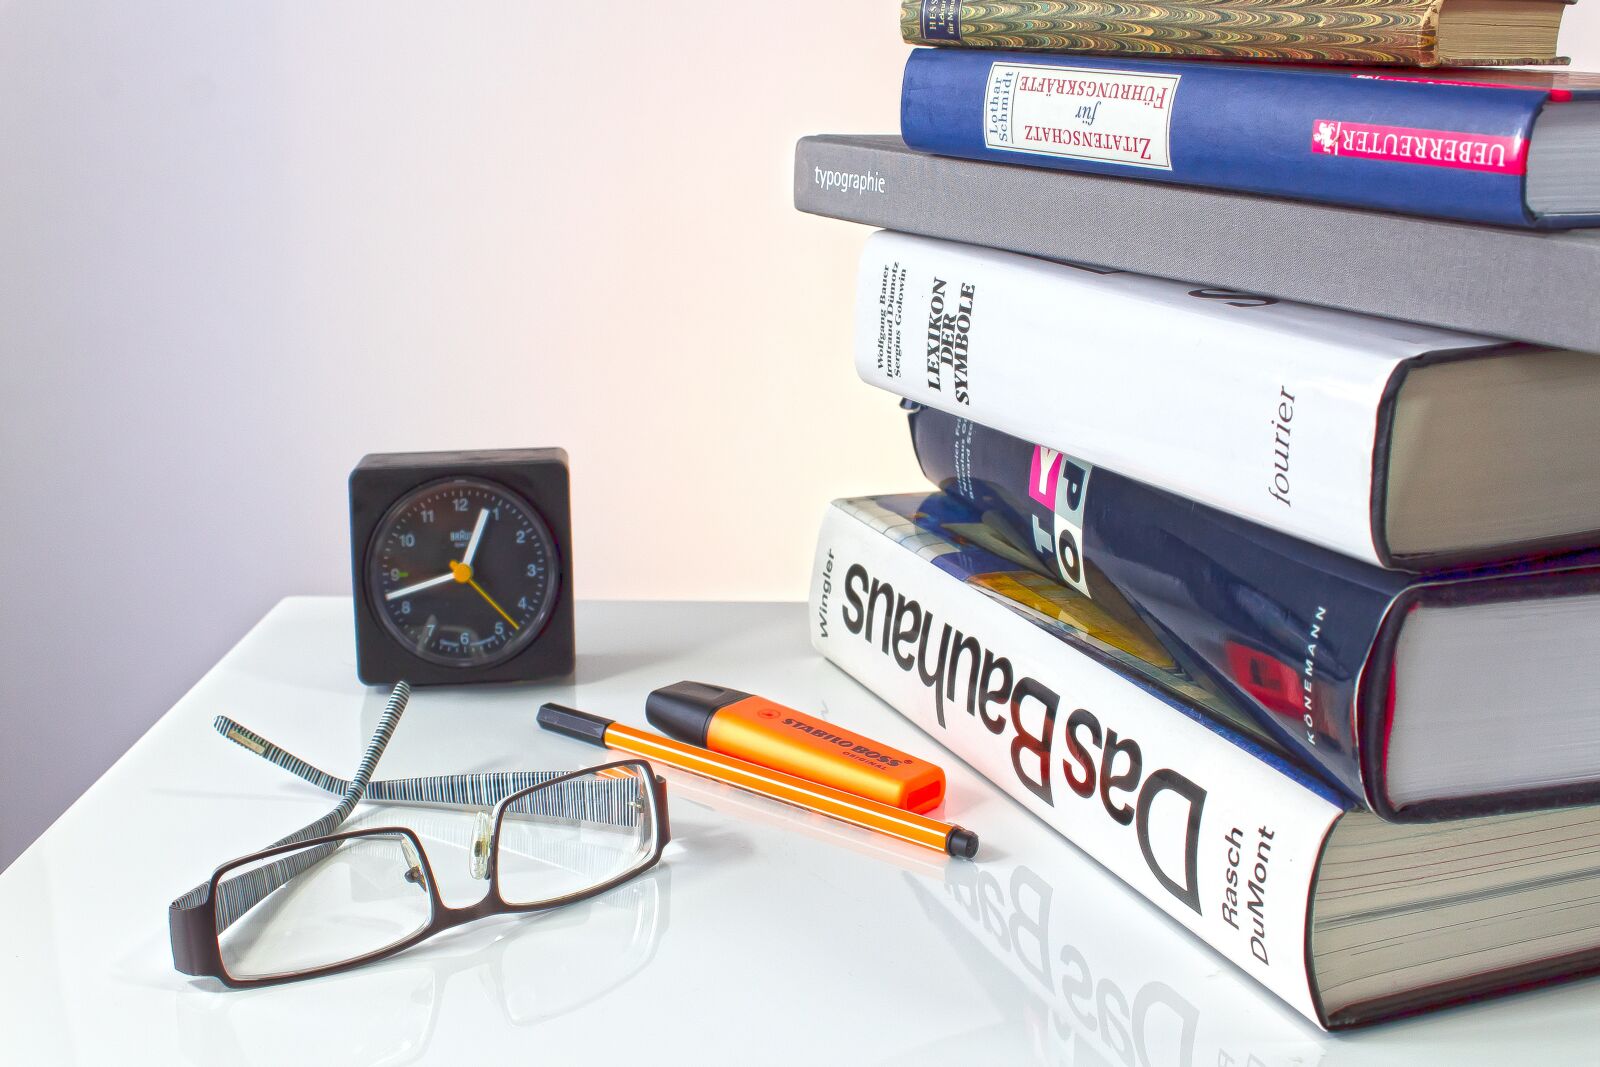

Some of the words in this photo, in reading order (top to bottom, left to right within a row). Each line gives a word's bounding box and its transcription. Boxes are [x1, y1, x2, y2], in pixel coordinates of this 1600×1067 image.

[989, 77, 1003, 134] Lothar
[999, 72, 1014, 142] Schmidt
[1019, 76, 1168, 109] FÜHRUNGSKRÄFTE
[1075, 101, 1102, 126] für
[1024, 125, 1152, 160] ZITATENSCHATZ
[1342, 130, 1506, 167] UEBERREUTER
[814, 166, 886, 195] typographie
[879, 265, 890, 305] Bauer
[886, 261, 900, 316] Dümotz
[894, 268, 907, 326] Golowin
[877, 308, 888, 369] Wolfgang
[886, 320, 894, 378] Irmtraud
[927, 276, 947, 392] LEXIKON
[940, 313, 957, 368] DER
[954, 282, 976, 406] SYMBOLE
[893, 330, 902, 378] Sergius
[1268, 385, 1296, 507] fourier
[420, 510, 435, 523] 11
[452, 499, 469, 511] 12
[492, 508, 500, 520] 1
[399, 534, 415, 547] 10
[516, 530, 525, 543] 2
[390, 568, 400, 581] 9
[527, 564, 536, 577] 3
[401, 601, 411, 614] 8
[517, 597, 527, 609] 4
[817, 548, 835, 638] Wingler
[426, 624, 435, 637] 7
[459, 632, 469, 645] 6
[494, 622, 503, 635] 5
[841, 563, 1061, 808] Bauhaus
[1303, 605, 1327, 745] KÖNEMANN
[781, 718, 854, 747] STABILO
[842, 751, 888, 771] ORIGINAL
[1062, 708, 1208, 917] Das
[1221, 827, 1244, 931] Rasch
[1247, 825, 1275, 966] DuMont
